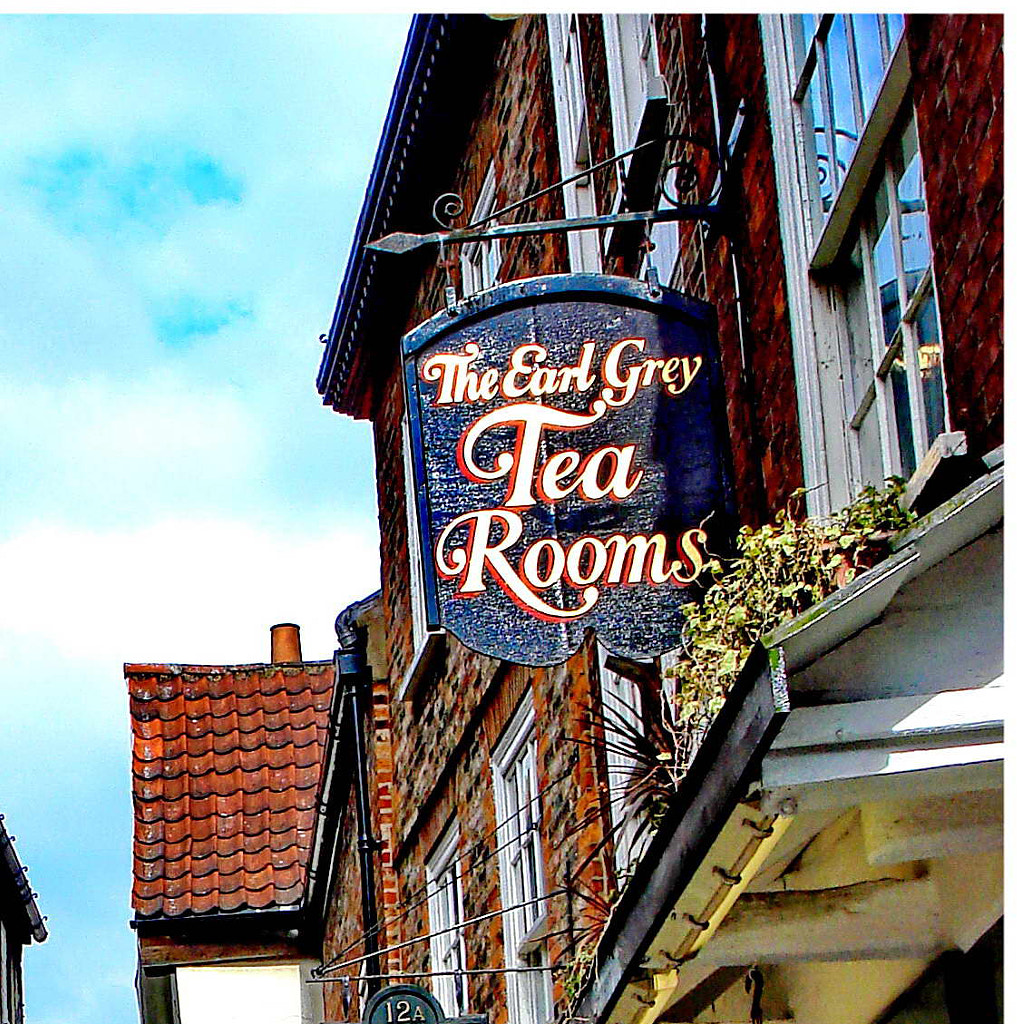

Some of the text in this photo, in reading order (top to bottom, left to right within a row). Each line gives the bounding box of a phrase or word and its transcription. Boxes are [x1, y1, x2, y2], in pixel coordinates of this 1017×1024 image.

[423, 338, 703, 408] The Earl Grey
[458, 400, 644, 509] Tea
[435, 508, 709, 623] Rooms
[385, 1000, 426, 1024] 12A
